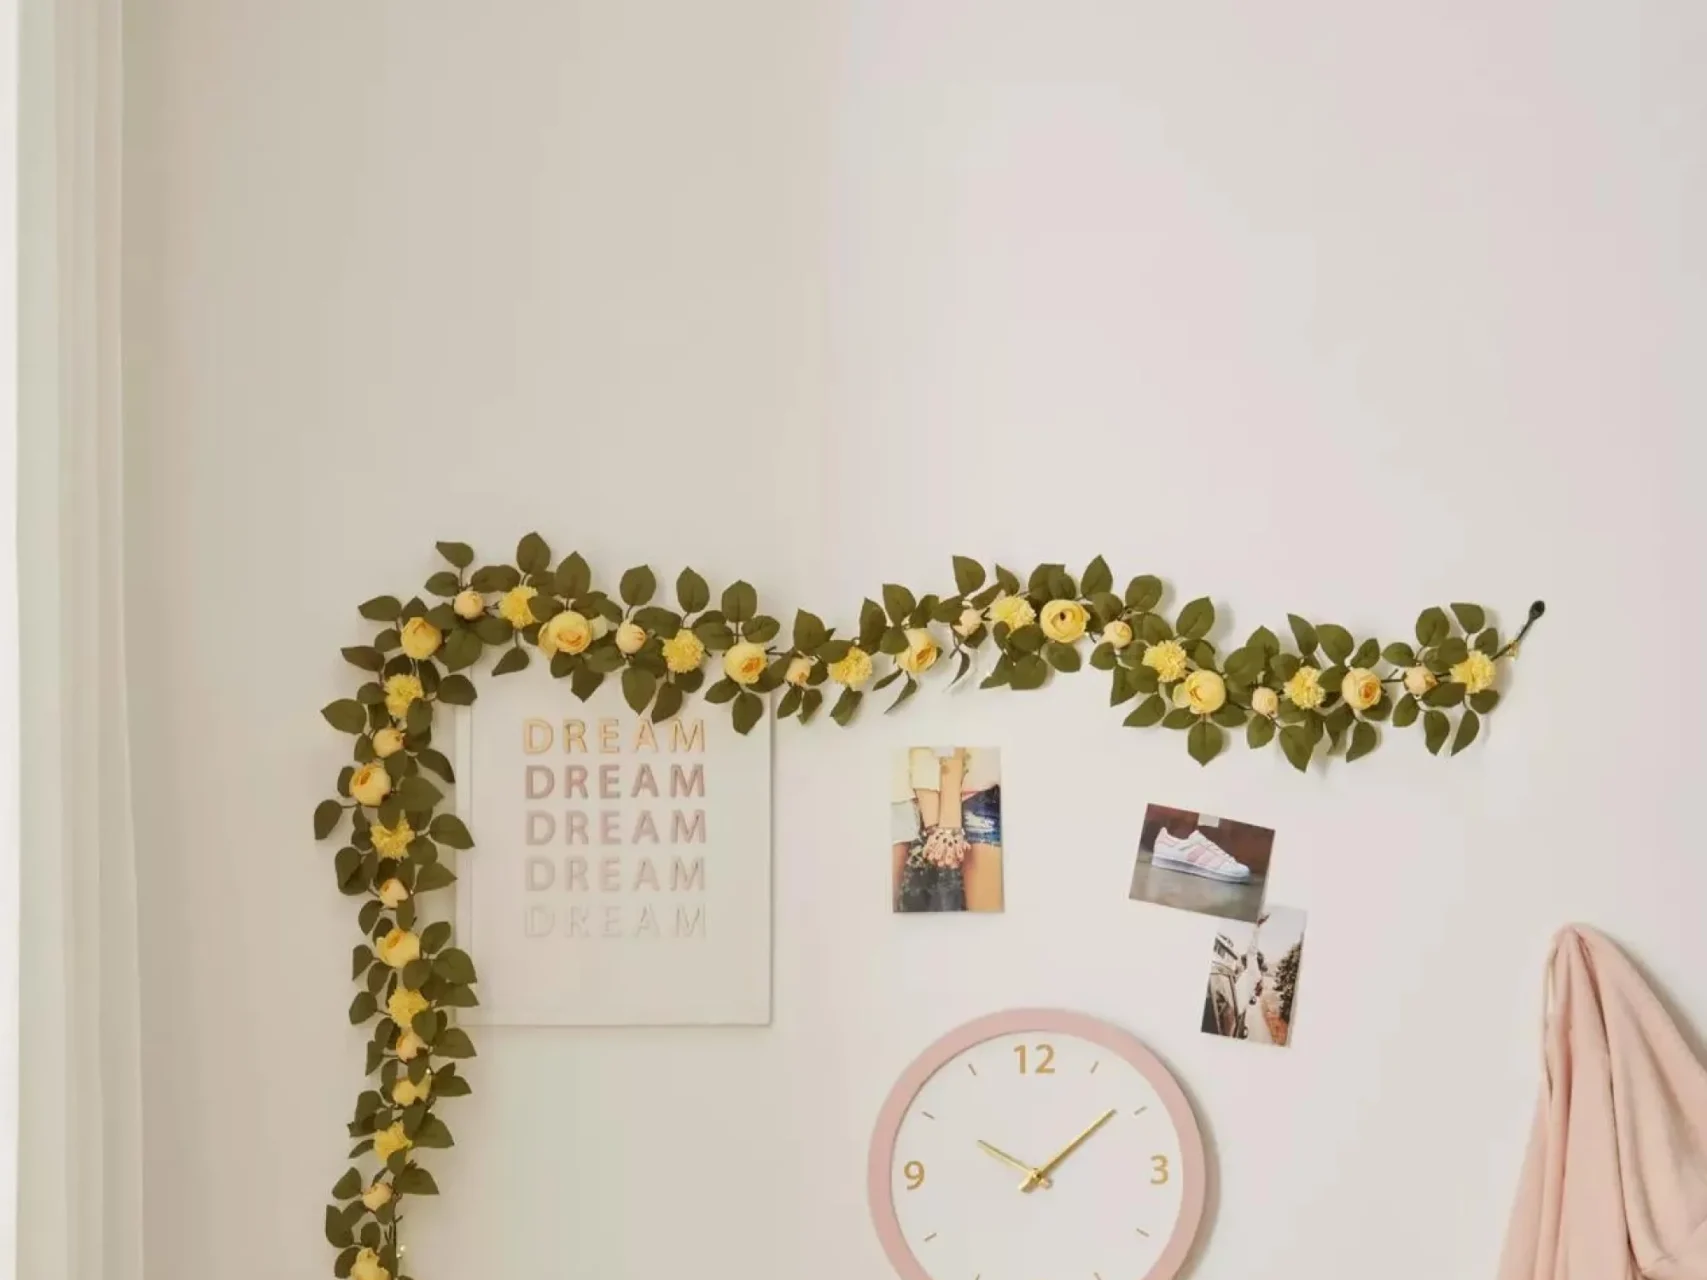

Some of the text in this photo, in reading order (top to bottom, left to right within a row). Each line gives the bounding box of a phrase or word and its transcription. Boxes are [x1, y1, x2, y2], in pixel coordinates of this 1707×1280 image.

[523, 717, 706, 754] DREAM
[524, 764, 706, 799] DREAM
[525, 809, 706, 845] DREAM
[524, 856, 706, 892] DREAM
[524, 905, 706, 939] DREAM
[1013, 1044, 1055, 1074] 12
[903, 1160, 925, 1190] 9
[1150, 1155, 1169, 1185] 3
